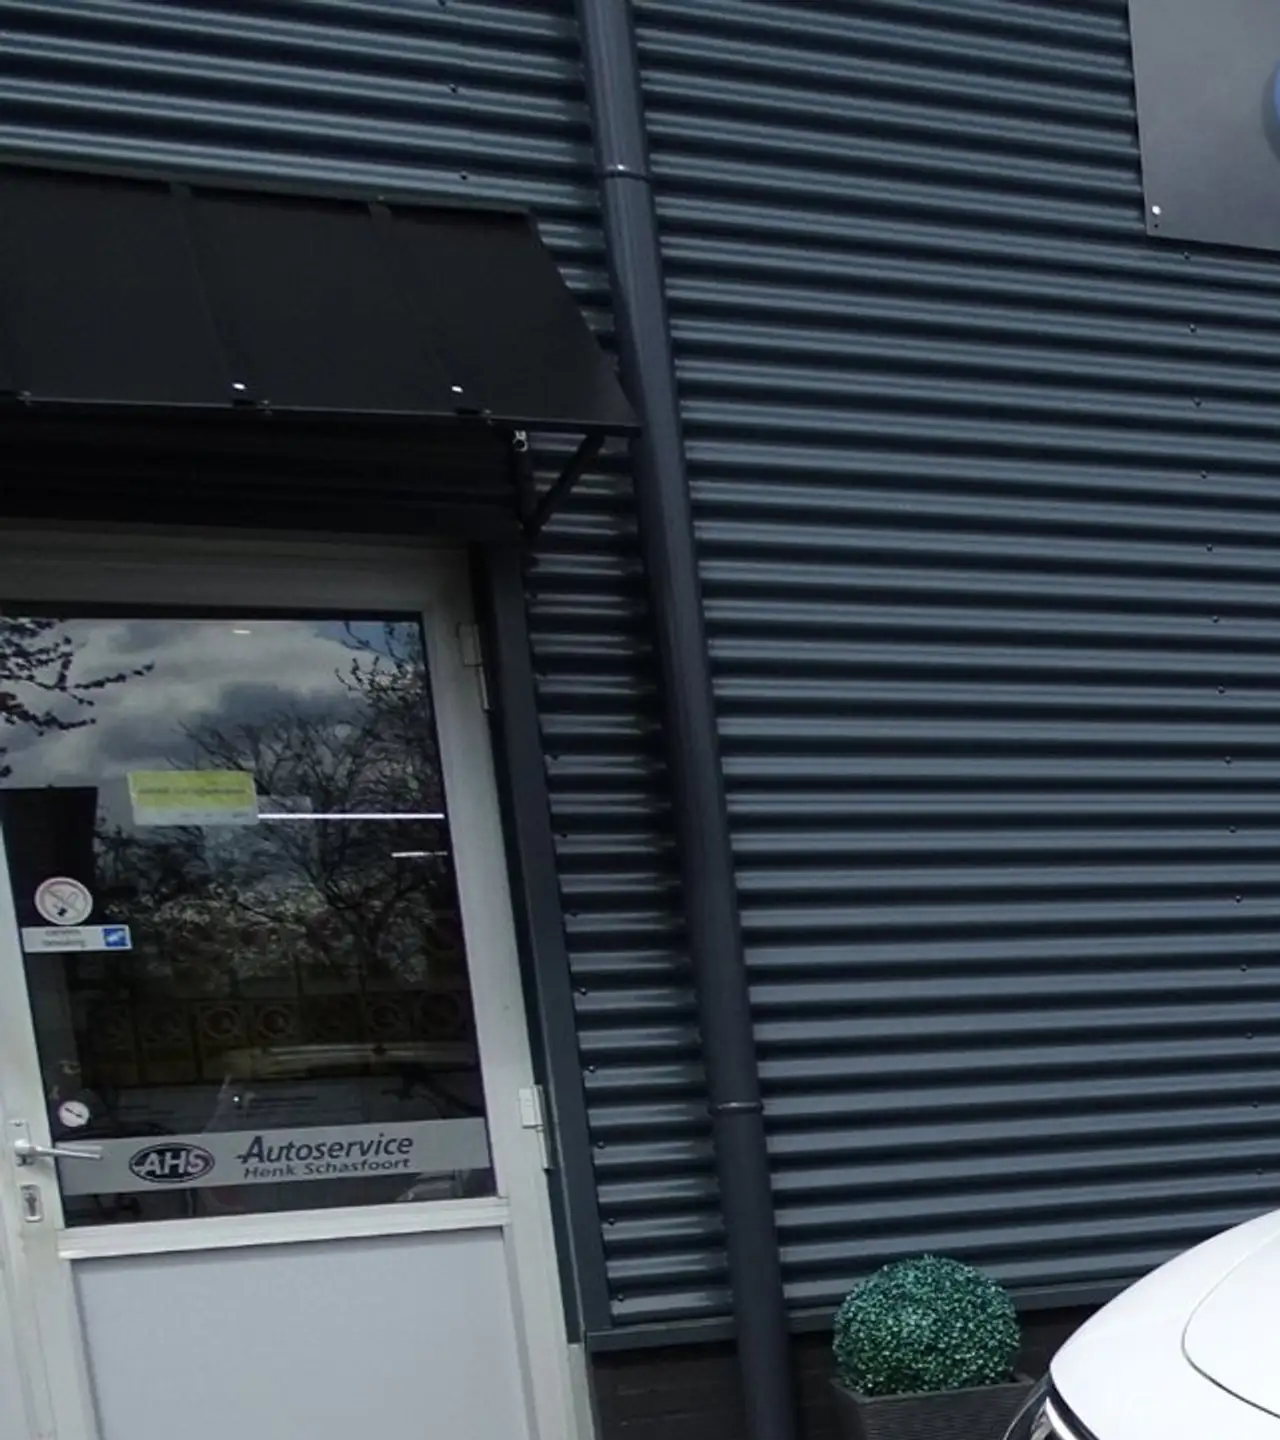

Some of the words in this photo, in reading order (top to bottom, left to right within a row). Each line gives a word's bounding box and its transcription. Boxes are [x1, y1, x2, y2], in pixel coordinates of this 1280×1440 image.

[237, 1132, 414, 1165] Autoservice
[146, 1150, 207, 1175] AHS
[243, 1165, 298, 1180] Henk
[303, 1157, 411, 1177] Schasfoort
